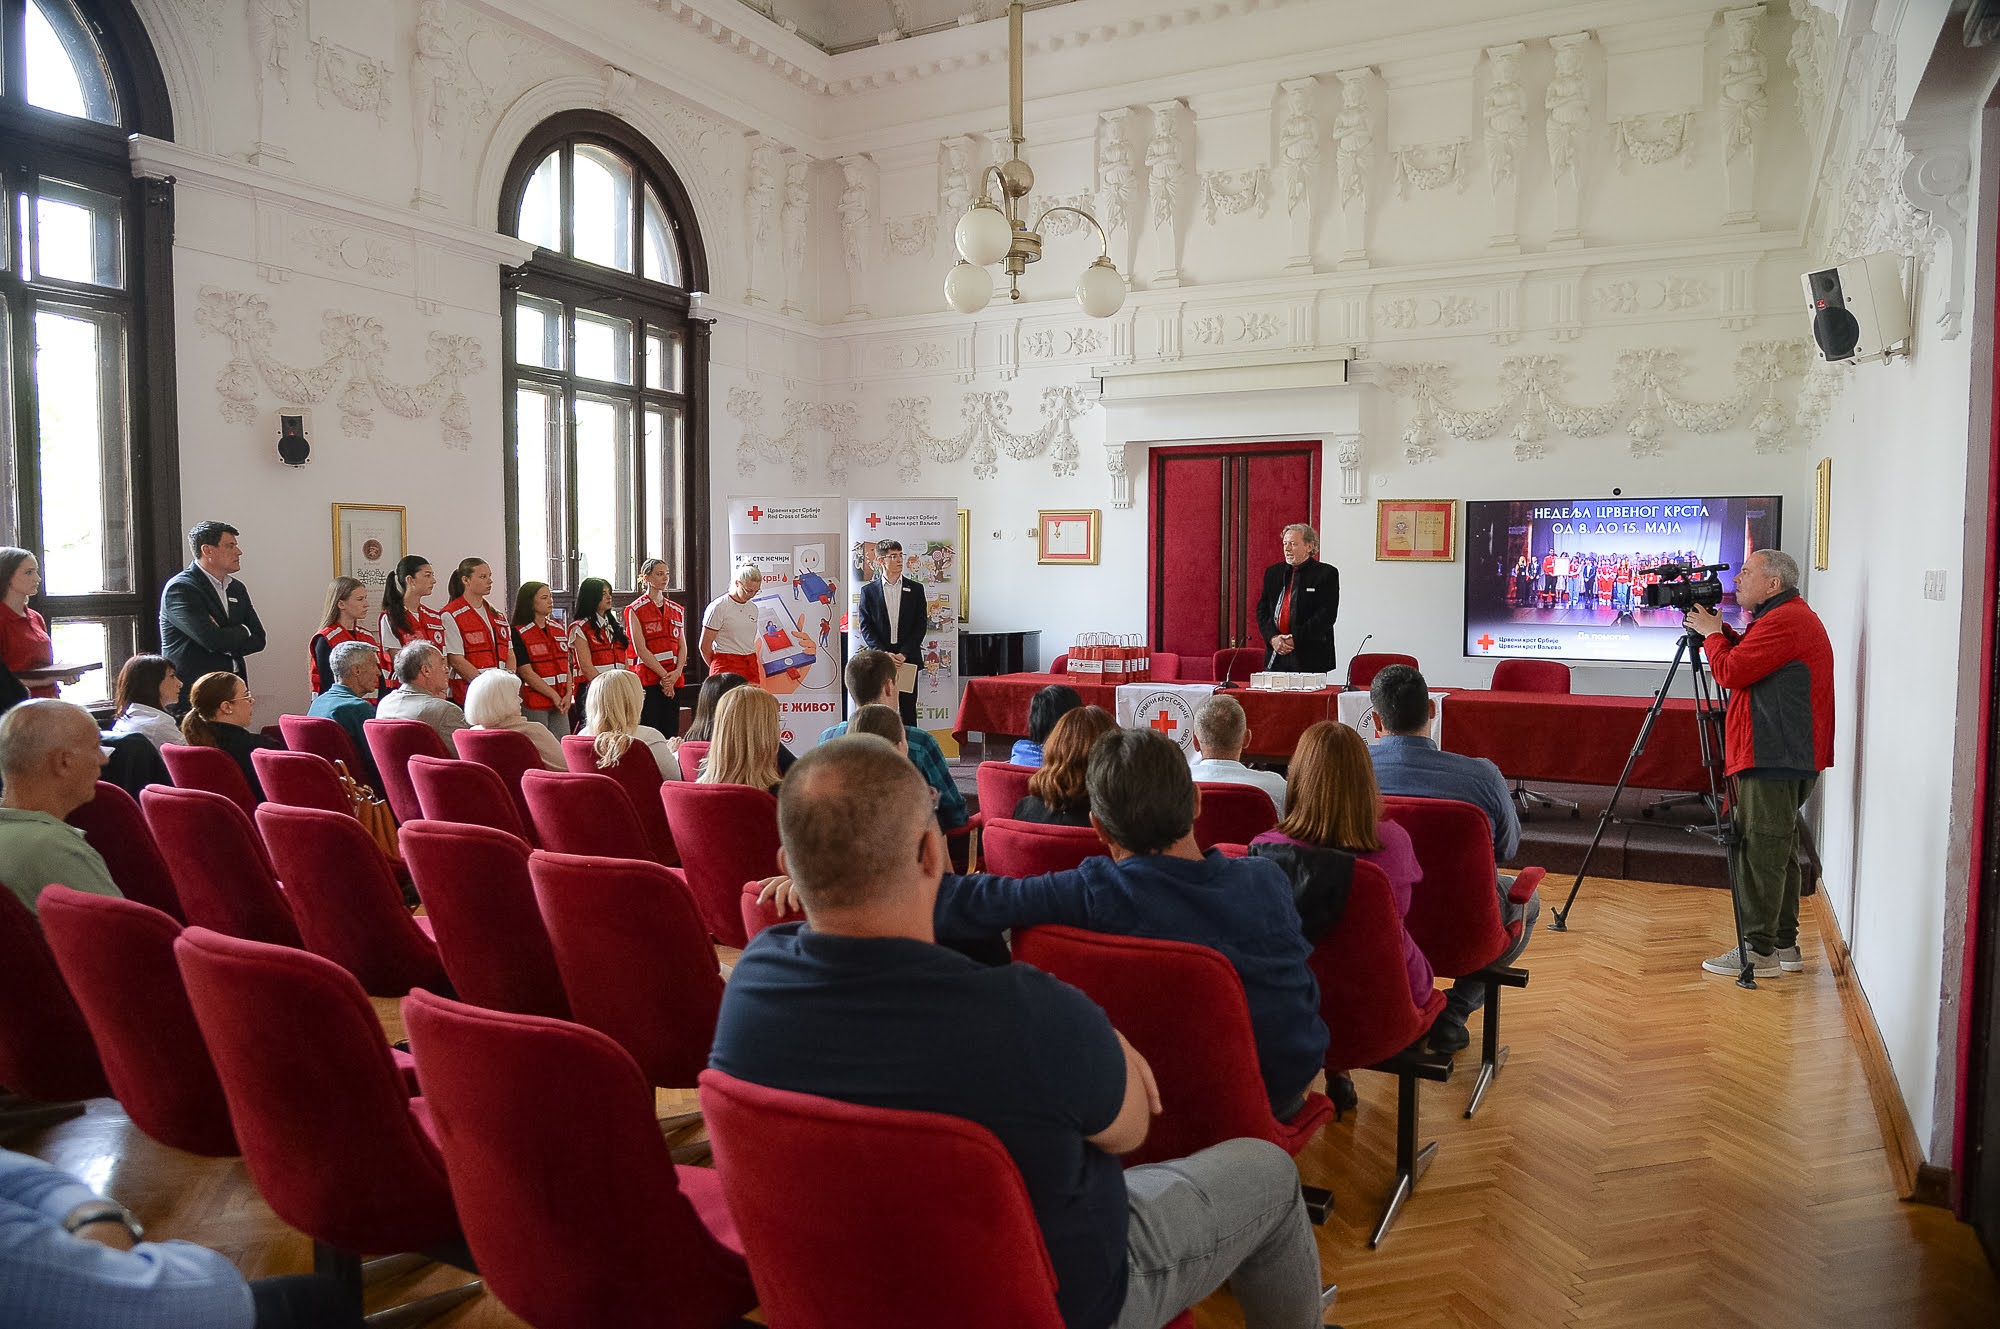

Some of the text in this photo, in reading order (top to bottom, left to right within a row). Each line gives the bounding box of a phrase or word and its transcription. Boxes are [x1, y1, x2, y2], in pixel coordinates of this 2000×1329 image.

[1534, 505, 1709, 520] НЕДЕЉА ЦРВЕНОГ КРСТА
[1552, 521, 1681, 535] ОД 8. ДО 15. МАЈА
[791, 702, 836, 712] ЖИВОТ
[926, 707, 949, 719] ТИ!
[1138, 697, 1158, 719] ЦРВЕНИ
[1172, 699, 1190, 720] СРБИЈЕ
